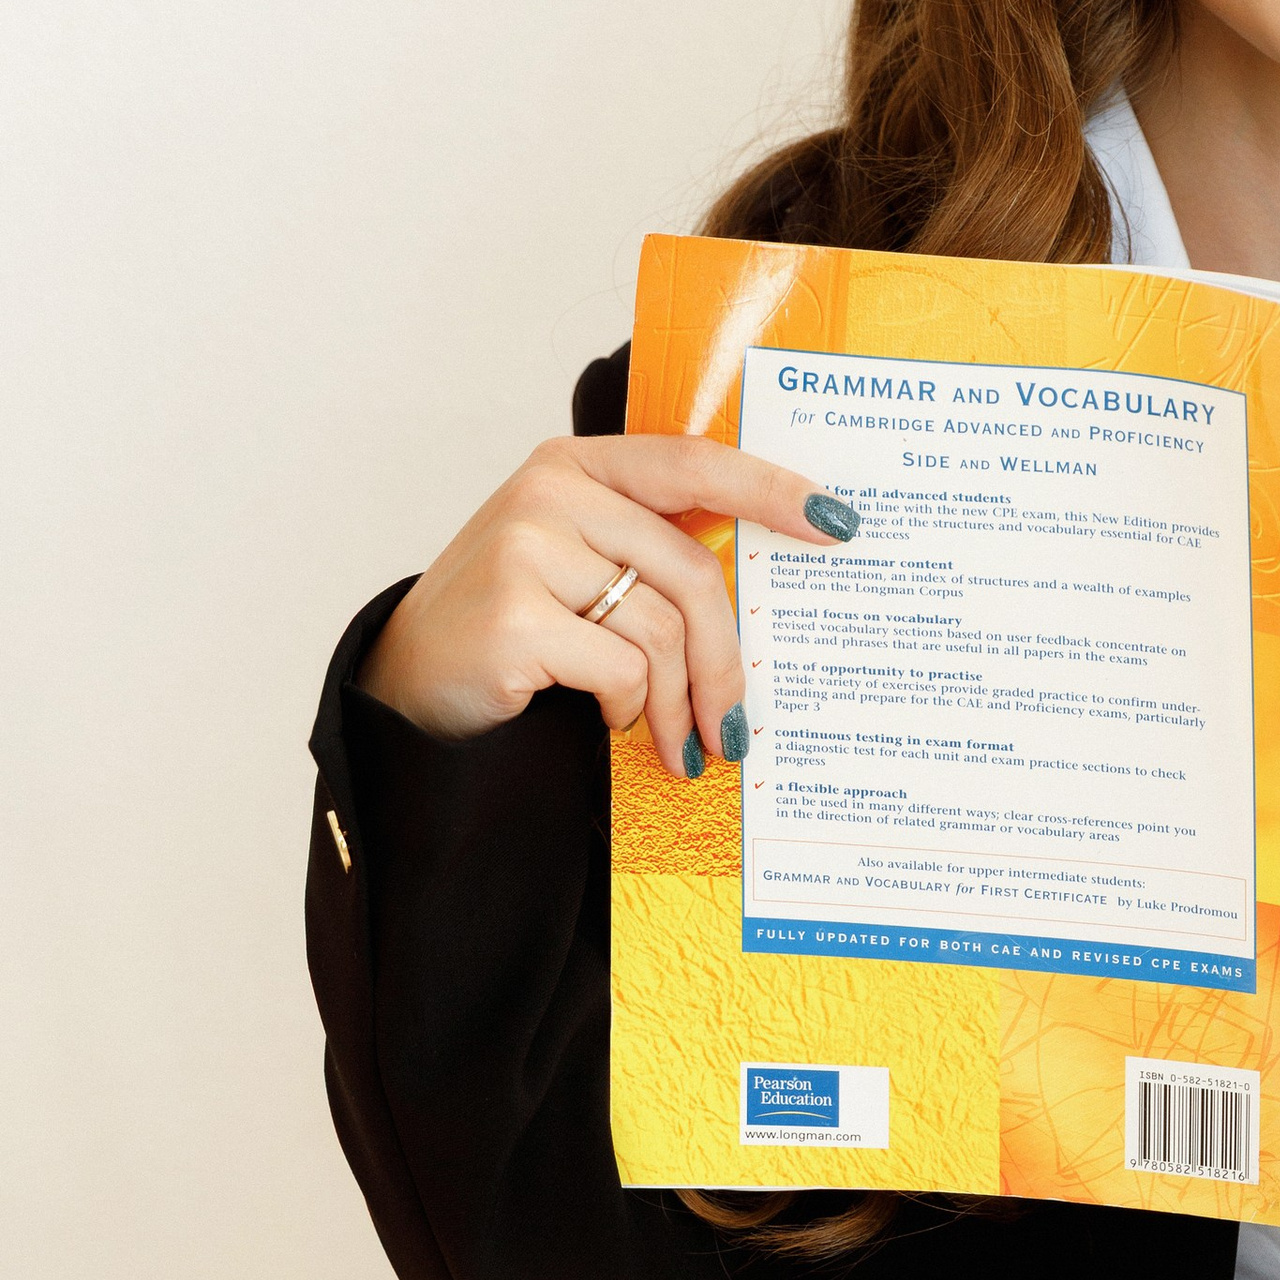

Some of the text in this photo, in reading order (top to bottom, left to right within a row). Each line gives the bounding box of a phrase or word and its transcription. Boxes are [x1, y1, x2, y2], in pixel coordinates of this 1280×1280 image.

[777, 365, 1215, 425] GRAMMAR AND VOCABULARY
[790, 408, 1204, 454] for CAMBRIDGE ADVANCED AND PROFICIENCY
[902, 451, 1097, 476] SIDE AND WELLMAN
[834, 485, 856, 497] for
[858, 487, 877, 498] all
[881, 488, 948, 501] advanced
[951, 492, 1011, 504] students
[857, 500, 871, 511] in
[875, 501, 900, 512] line
[903, 503, 933, 514] with
[936, 504, 958, 515] the
[961, 507, 988, 516] new
[991, 507, 1018, 518] CPE
[1064, 510, 1088, 522] this
[1092, 512, 1119, 524] New
[1123, 515, 1168, 530] Edition
[1171, 523, 1220, 538] provides
[865, 530, 910, 540] success
[890, 516, 903, 526] of
[907, 516, 929, 527] the
[932, 518, 995, 530] structures
[997, 521, 1023, 532] and
[1026, 523, 1097, 538] vocabulary
[1099, 529, 1152, 542] essential
[1155, 532, 1174, 544] for
[1176, 535, 1202, 548] CAE
[769, 551, 953, 570] detailed grammar content
[769, 564, 801, 576] clear
[890, 573, 907, 582] an
[911, 572, 947, 583] index
[950, 574, 963, 584] of
[967, 575, 1030, 588] structures
[1032, 578, 1057, 589] and
[1060, 582, 1069, 590] a
[1072, 582, 1115, 594] wealth
[1118, 585, 1132, 595] of
[1134, 588, 1192, 602] examples
[770, 577, 964, 601] based on the Longman Corpus
[771, 607, 963, 628] special focus on vocabulary
[773, 659, 983, 682] lots of opportunity to practise
[773, 687, 828, 702] standing
[831, 690, 856, 701] and
[859, 693, 907, 705] prepare
[910, 694, 929, 705] for
[932, 695, 953, 707] the
[956, 697, 983, 708] CAE
[986, 699, 1011, 710] and
[1015, 700, 1085, 717] Proficiency
[1135, 712, 1206, 731] particularly
[774, 698, 821, 714] Paper 3
[774, 728, 1014, 752] continuous testing in exam format
[775, 755, 826, 767] progress
[774, 781, 908, 799] a flexible approach
[857, 856, 884, 868] Also
[886, 859, 943, 872] available
[946, 862, 965, 874] for
[968, 866, 1005, 880] upper
[1008, 867, 1088, 884] intermediate
[762, 869, 1238, 920] GRAMMAR AND VOCABULARY for FIRST CERTIFICATE by Luke Prodromou
[756, 927, 1242, 978] FULLY UPDATED FOR BOTH CAE AND REVISED CPE EXAMS
[753, 1075, 813, 1092] Pearson
[1139, 1070, 1251, 1092] ISBN 0-582-51821-0
[760, 1091, 833, 1107] Education
[744, 1129, 862, 1142] www.longman.com
